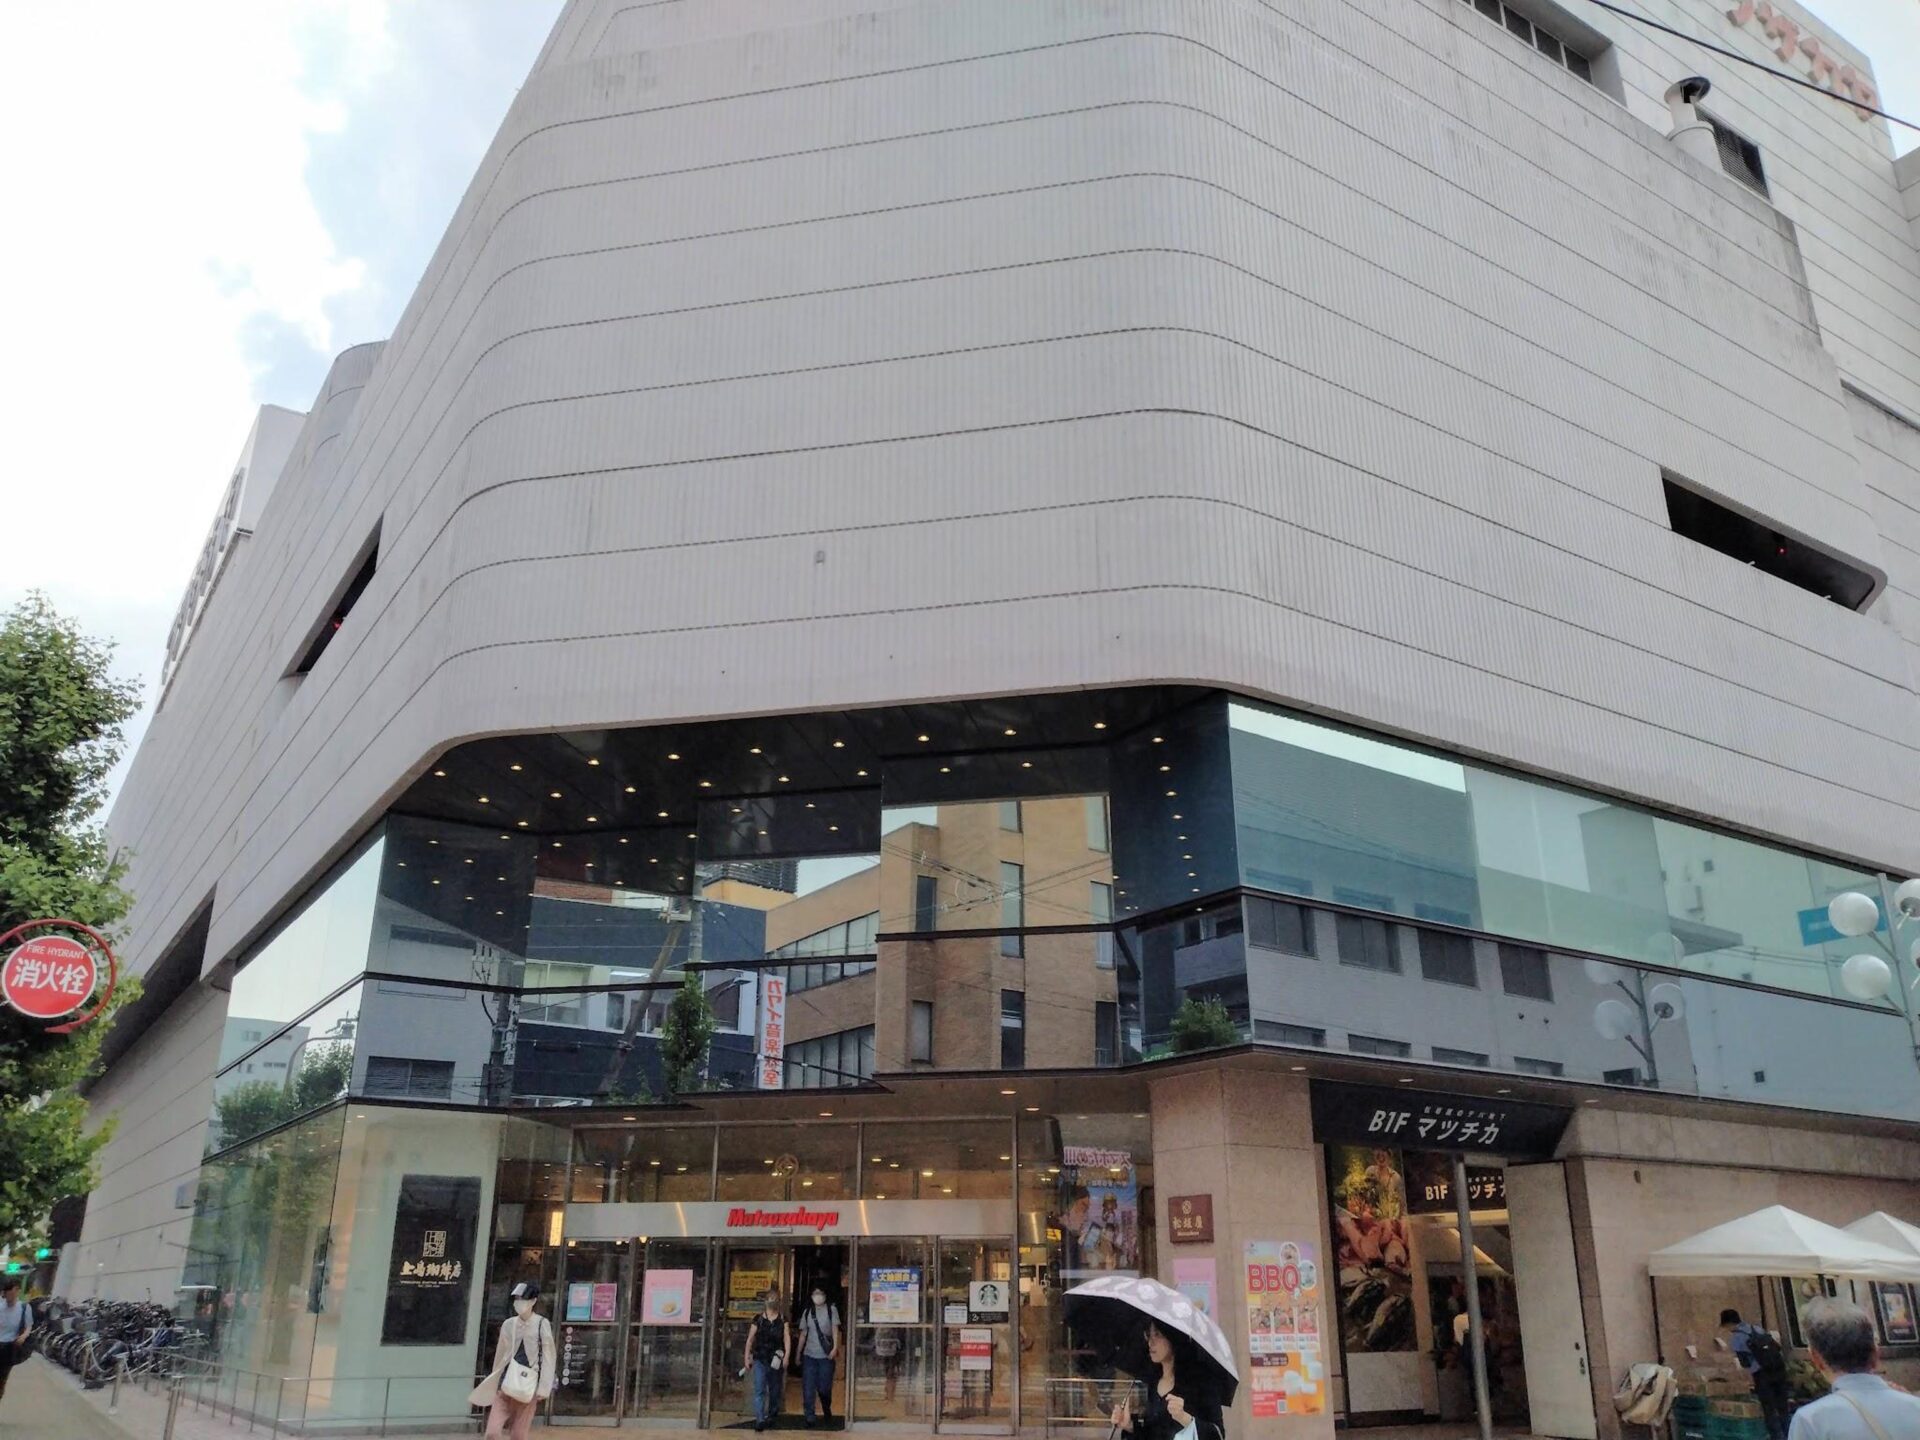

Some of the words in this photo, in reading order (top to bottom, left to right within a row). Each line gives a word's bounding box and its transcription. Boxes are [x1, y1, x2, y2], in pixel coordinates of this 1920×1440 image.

[26, 944, 46, 954] FIRE
[47, 946, 85, 959] HYDRANT
[10, 956, 89, 995] 消火栓
[1368, 1109, 1411, 1134] B1F
[1418, 1118, 1500, 1145] マツチカ
[1425, 1184, 1448, 1201] B1F
[727, 1205, 839, 1232] Matsuzakaya
[1248, 1263, 1299, 1294] BBQ
